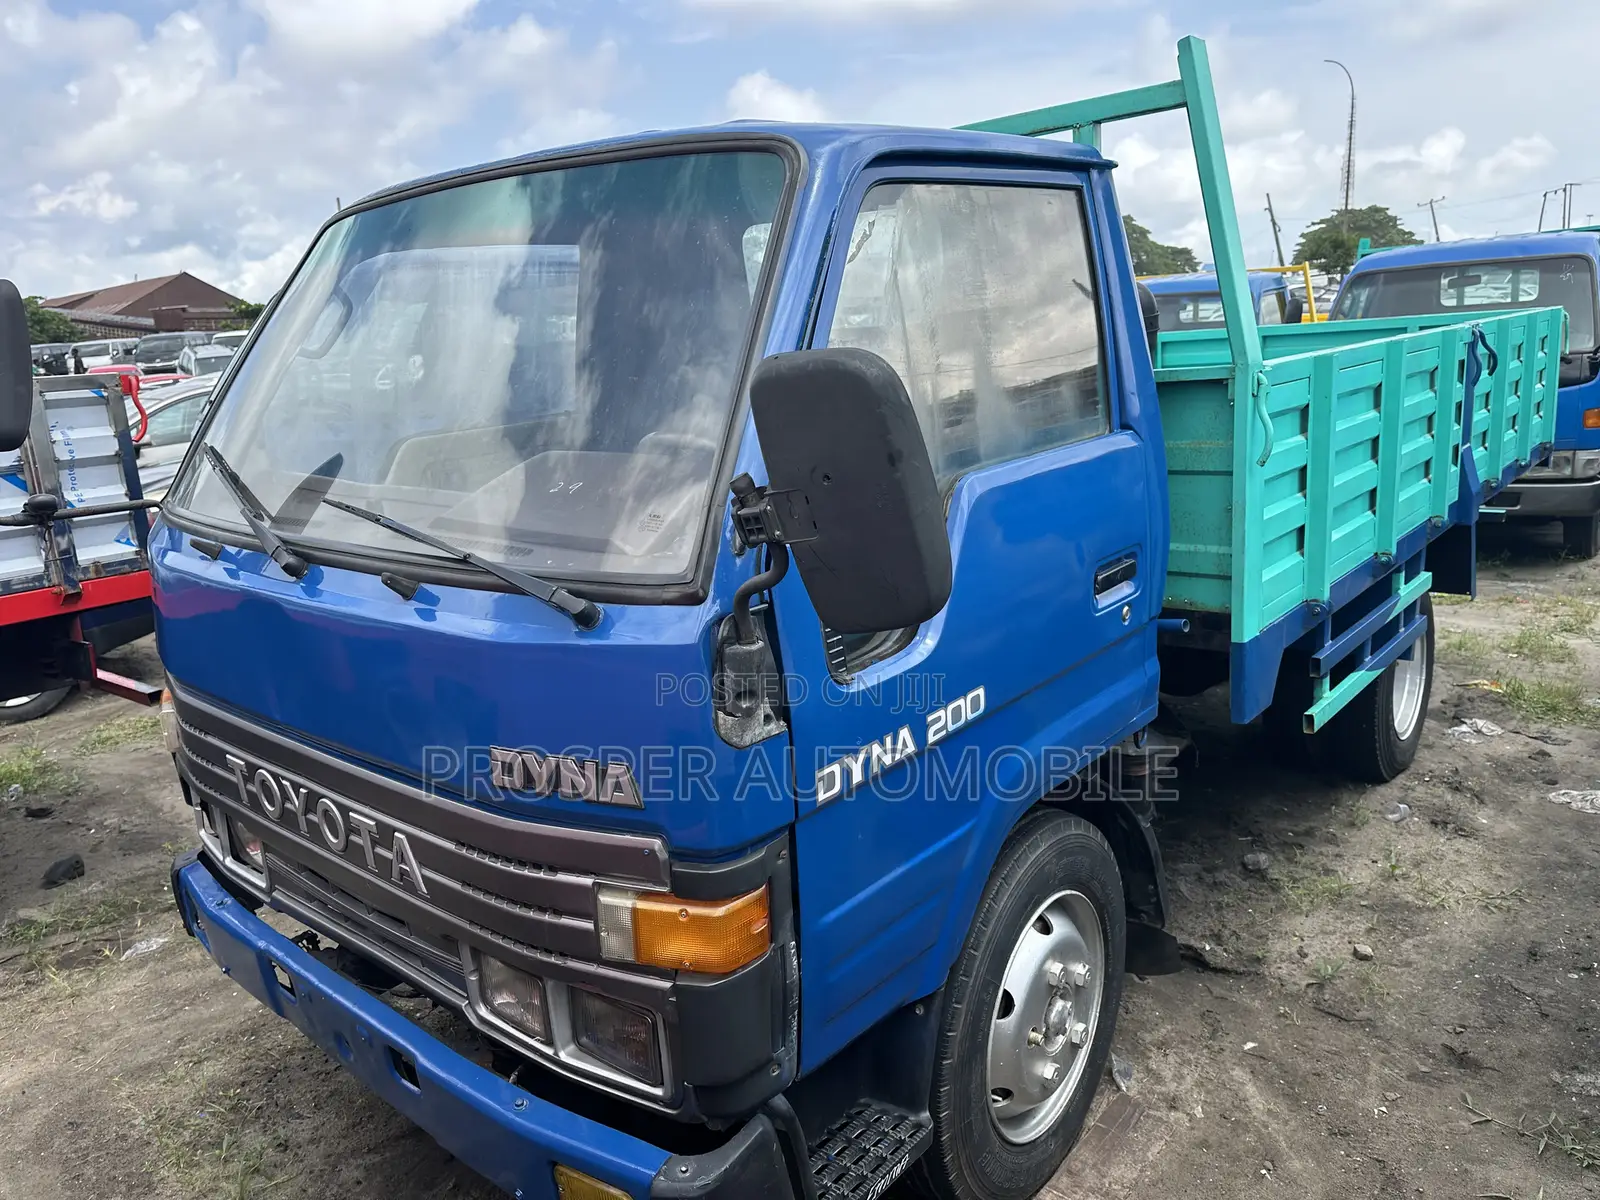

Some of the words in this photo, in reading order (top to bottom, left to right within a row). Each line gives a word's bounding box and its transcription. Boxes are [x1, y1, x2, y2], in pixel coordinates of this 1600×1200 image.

[67, 448, 79, 492] Proteve
[74, 492, 86, 503] PE
[489, 745, 645, 810] DYNA
[816, 724, 918, 807] DYNA
[926, 685, 986, 746] 200
[226, 754, 430, 898] TOYOTA
